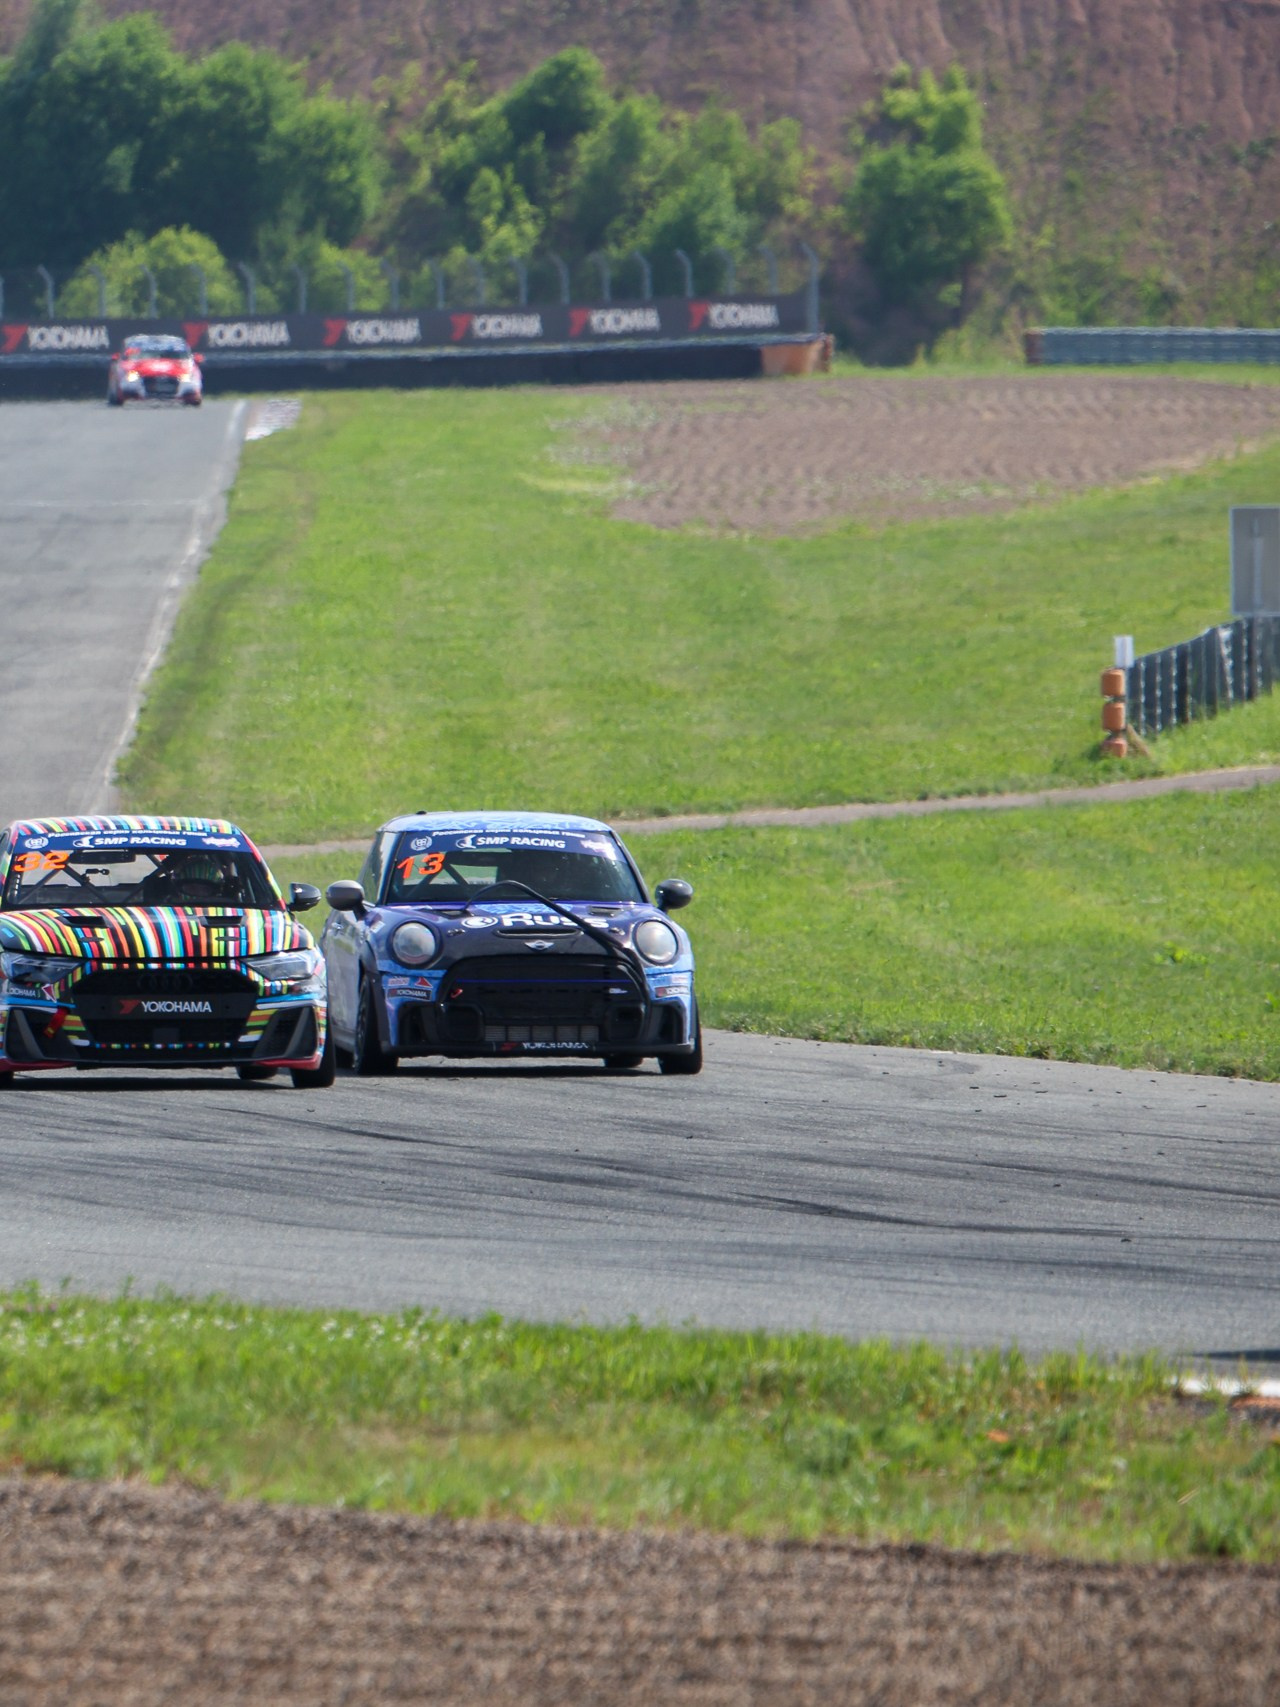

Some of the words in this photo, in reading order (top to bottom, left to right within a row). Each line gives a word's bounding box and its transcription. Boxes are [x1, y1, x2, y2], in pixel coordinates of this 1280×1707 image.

[94, 837, 129, 845] SMP
[130, 836, 187, 846] RACING
[476, 836, 510, 846] SMP
[511, 836, 566, 849] RACING
[13, 851, 69, 873] 32
[397, 853, 445, 879] 13
[141, 1001, 212, 1013] YOKOHAMA
